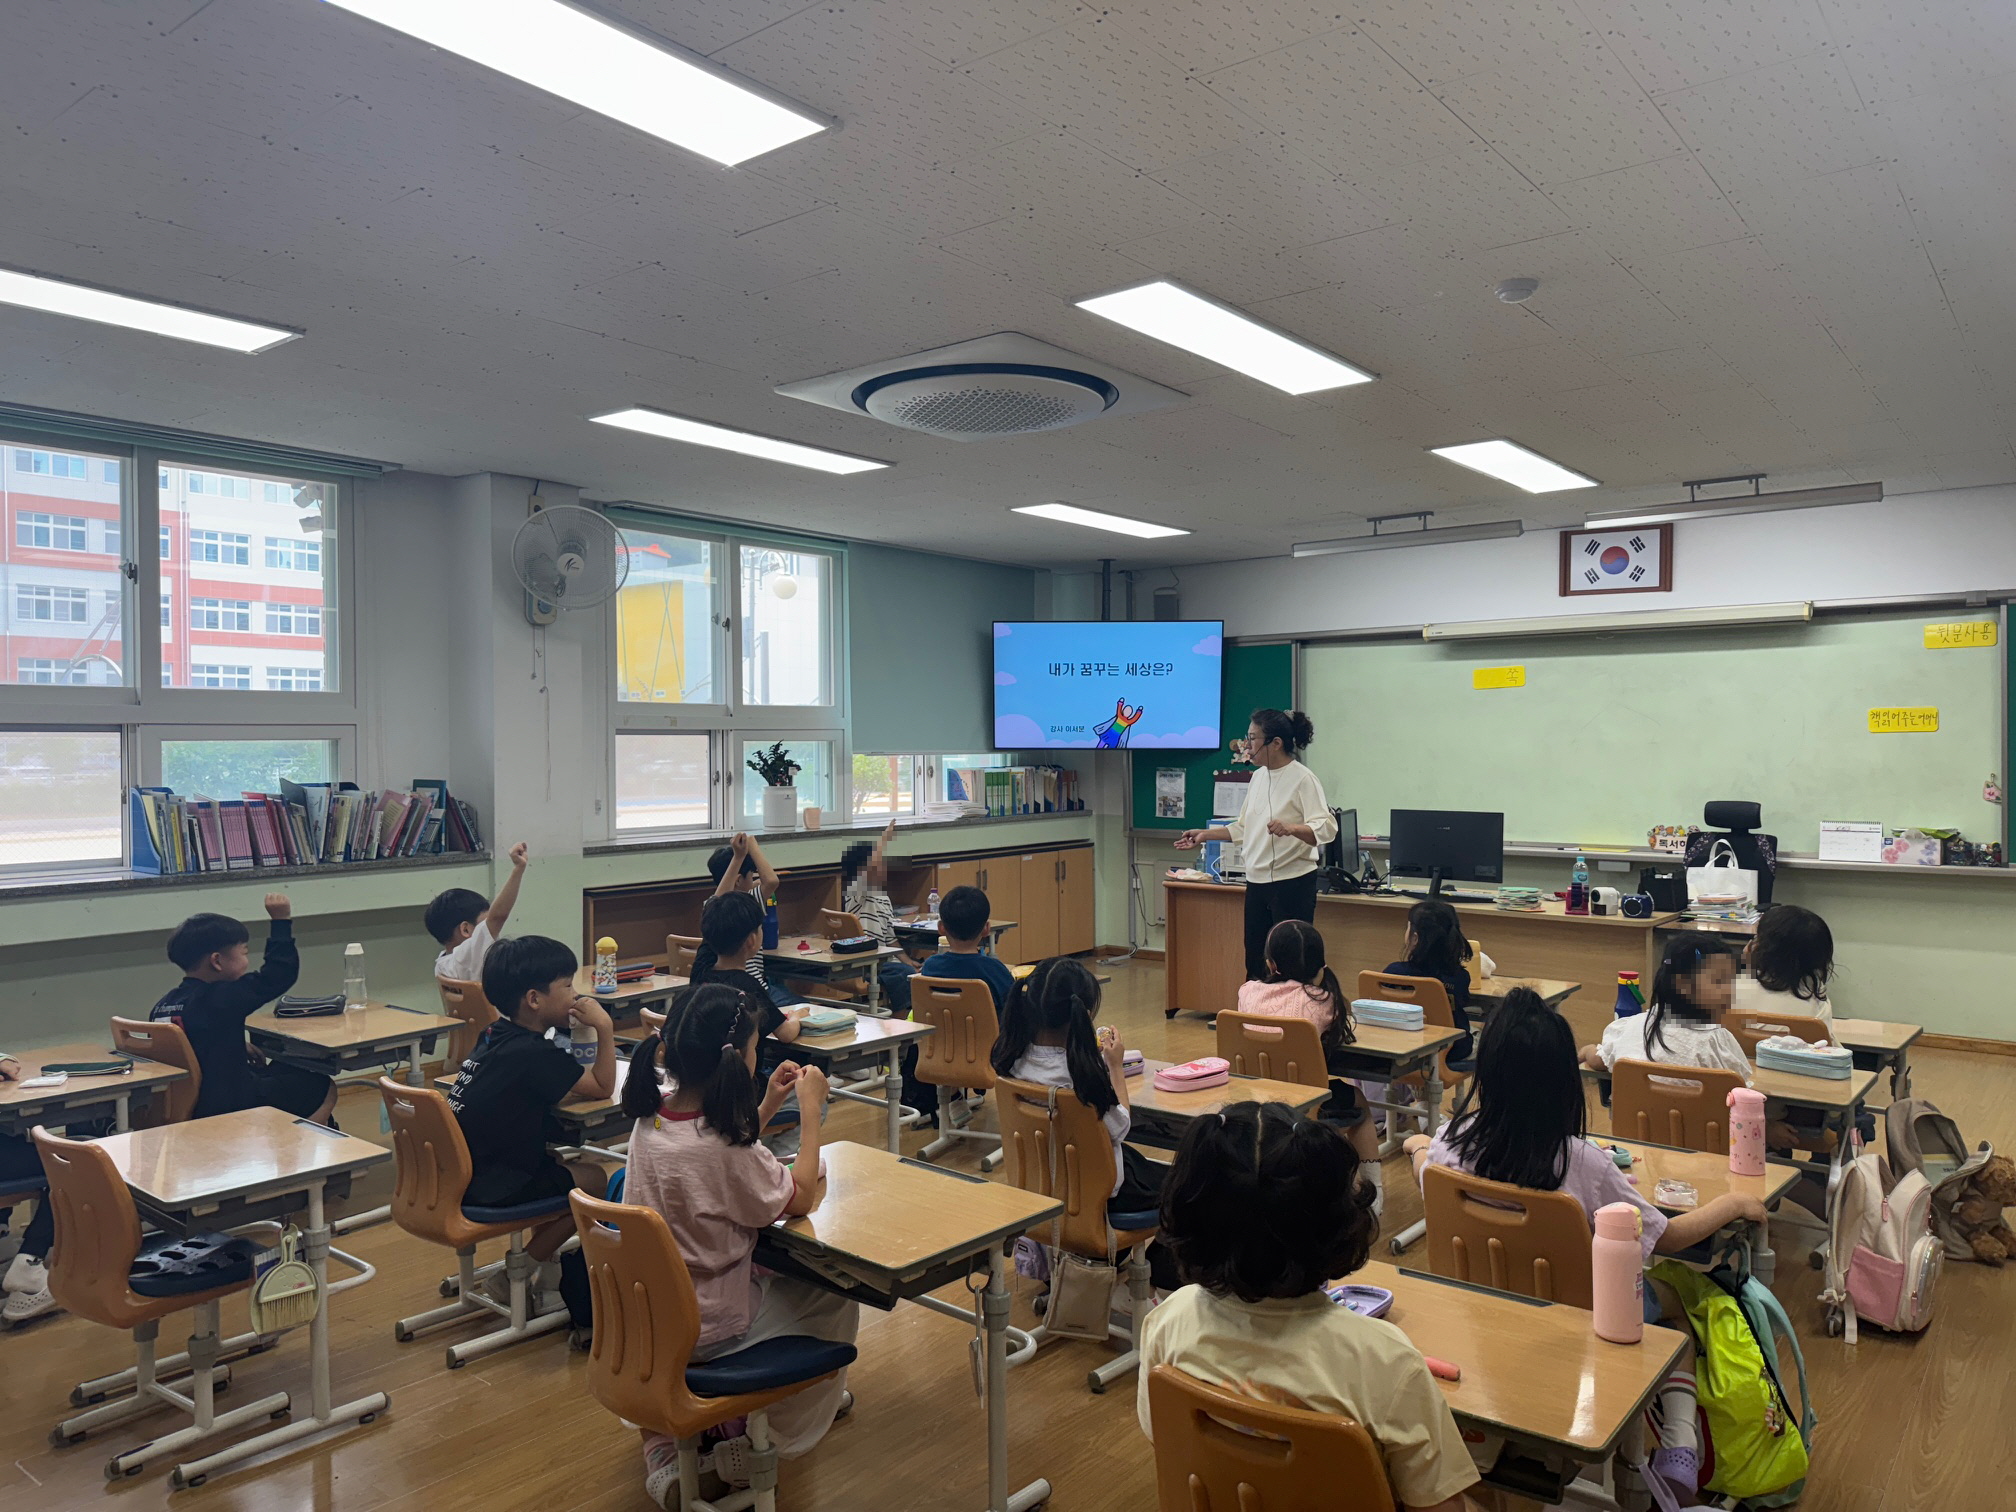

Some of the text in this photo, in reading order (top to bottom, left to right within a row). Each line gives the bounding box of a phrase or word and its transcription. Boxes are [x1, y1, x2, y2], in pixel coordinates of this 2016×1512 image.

[1048, 662, 1173, 677] 내가 꿈꾸는 세상은?
